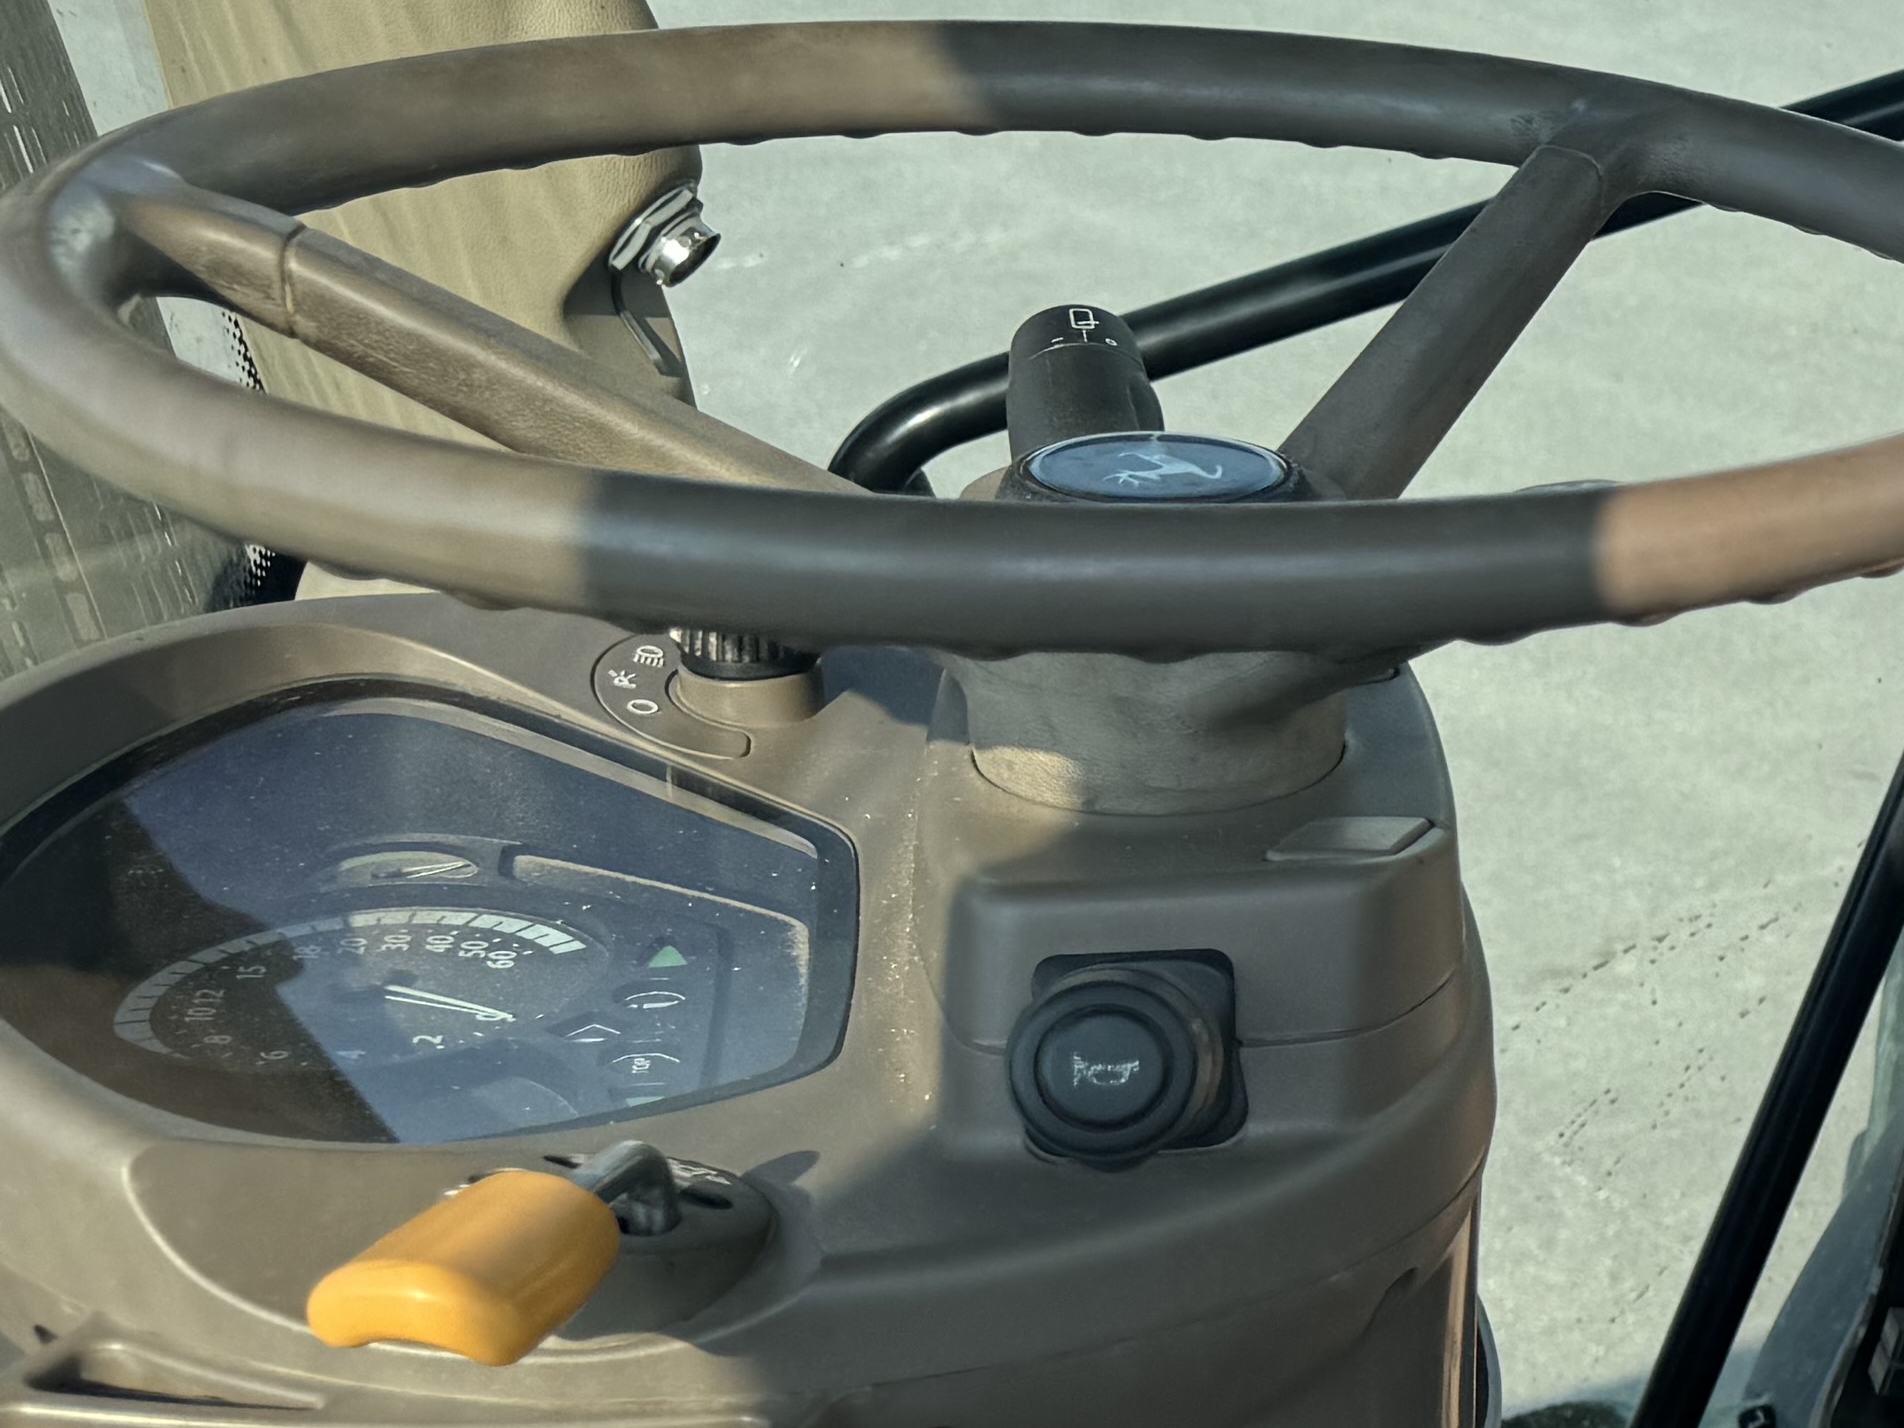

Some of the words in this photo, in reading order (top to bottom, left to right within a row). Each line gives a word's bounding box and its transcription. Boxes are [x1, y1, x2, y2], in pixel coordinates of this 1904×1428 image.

[337, 936, 368, 956] 20
[380, 933, 412, 952] 30
[424, 934, 455, 953] 40
[457, 939, 489, 959] 50
[292, 944, 322, 961] 18
[486, 950, 518, 969] 60
[235, 964, 267, 980] 15
[192, 988, 225, 1004] 12
[184, 1006, 218, 1023] 10
[203, 1034, 233, 1046] 8
[412, 1034, 444, 1046] 2
[259, 1049, 290, 1061] 6
[336, 1049, 366, 1060] 4
